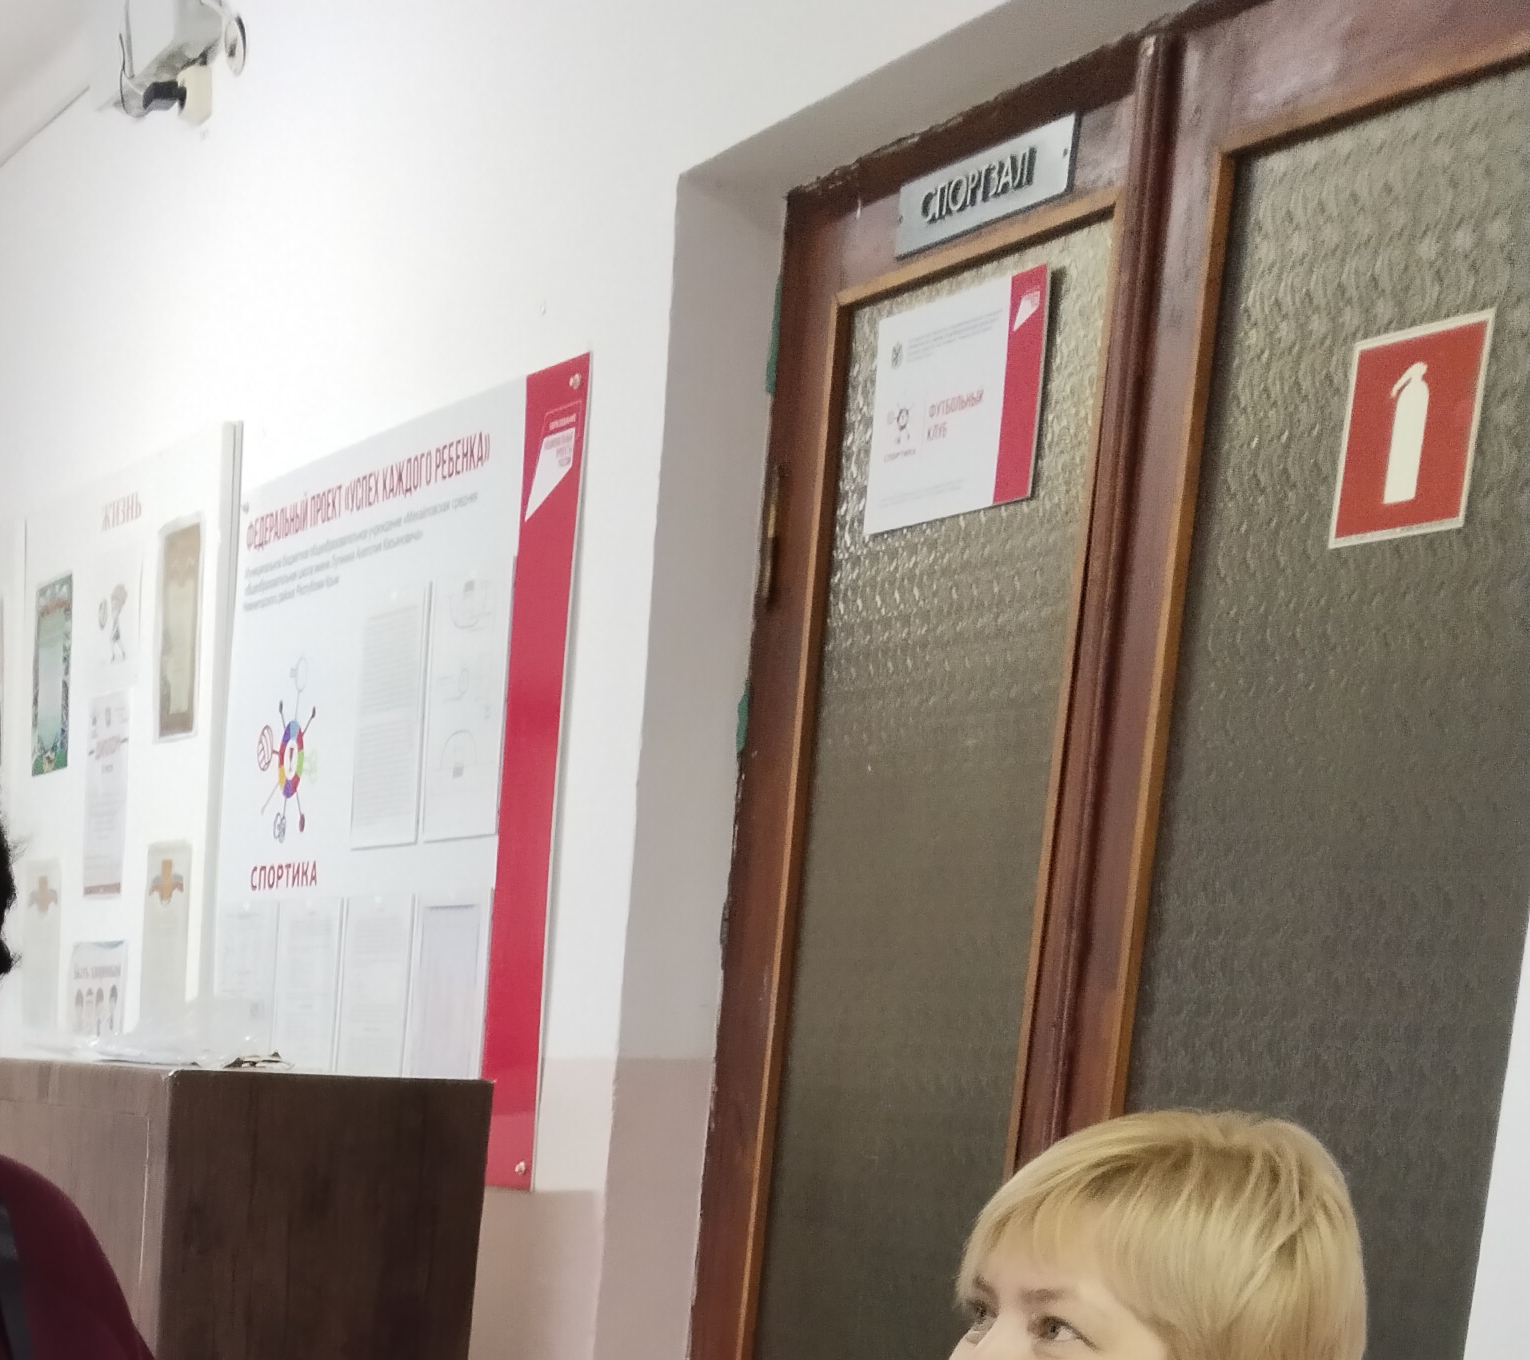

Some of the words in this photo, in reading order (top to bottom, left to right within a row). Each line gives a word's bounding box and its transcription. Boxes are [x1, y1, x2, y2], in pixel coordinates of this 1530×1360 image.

[922, 146, 1037, 224] СПОРТЗАЛ
[102, 491, 142, 532] ЖИЗНЬ
[246, 491, 309, 551] ФЕДЕРАЛЬНЫЙ
[310, 484, 343, 527] ПРОЕКТ
[345, 470, 380, 513] «УСПЕХ
[382, 450, 432, 501] КАЖДОГО
[434, 431, 491, 482] РЕБЕНКА»
[250, 861, 318, 892] СПОРТИКА
